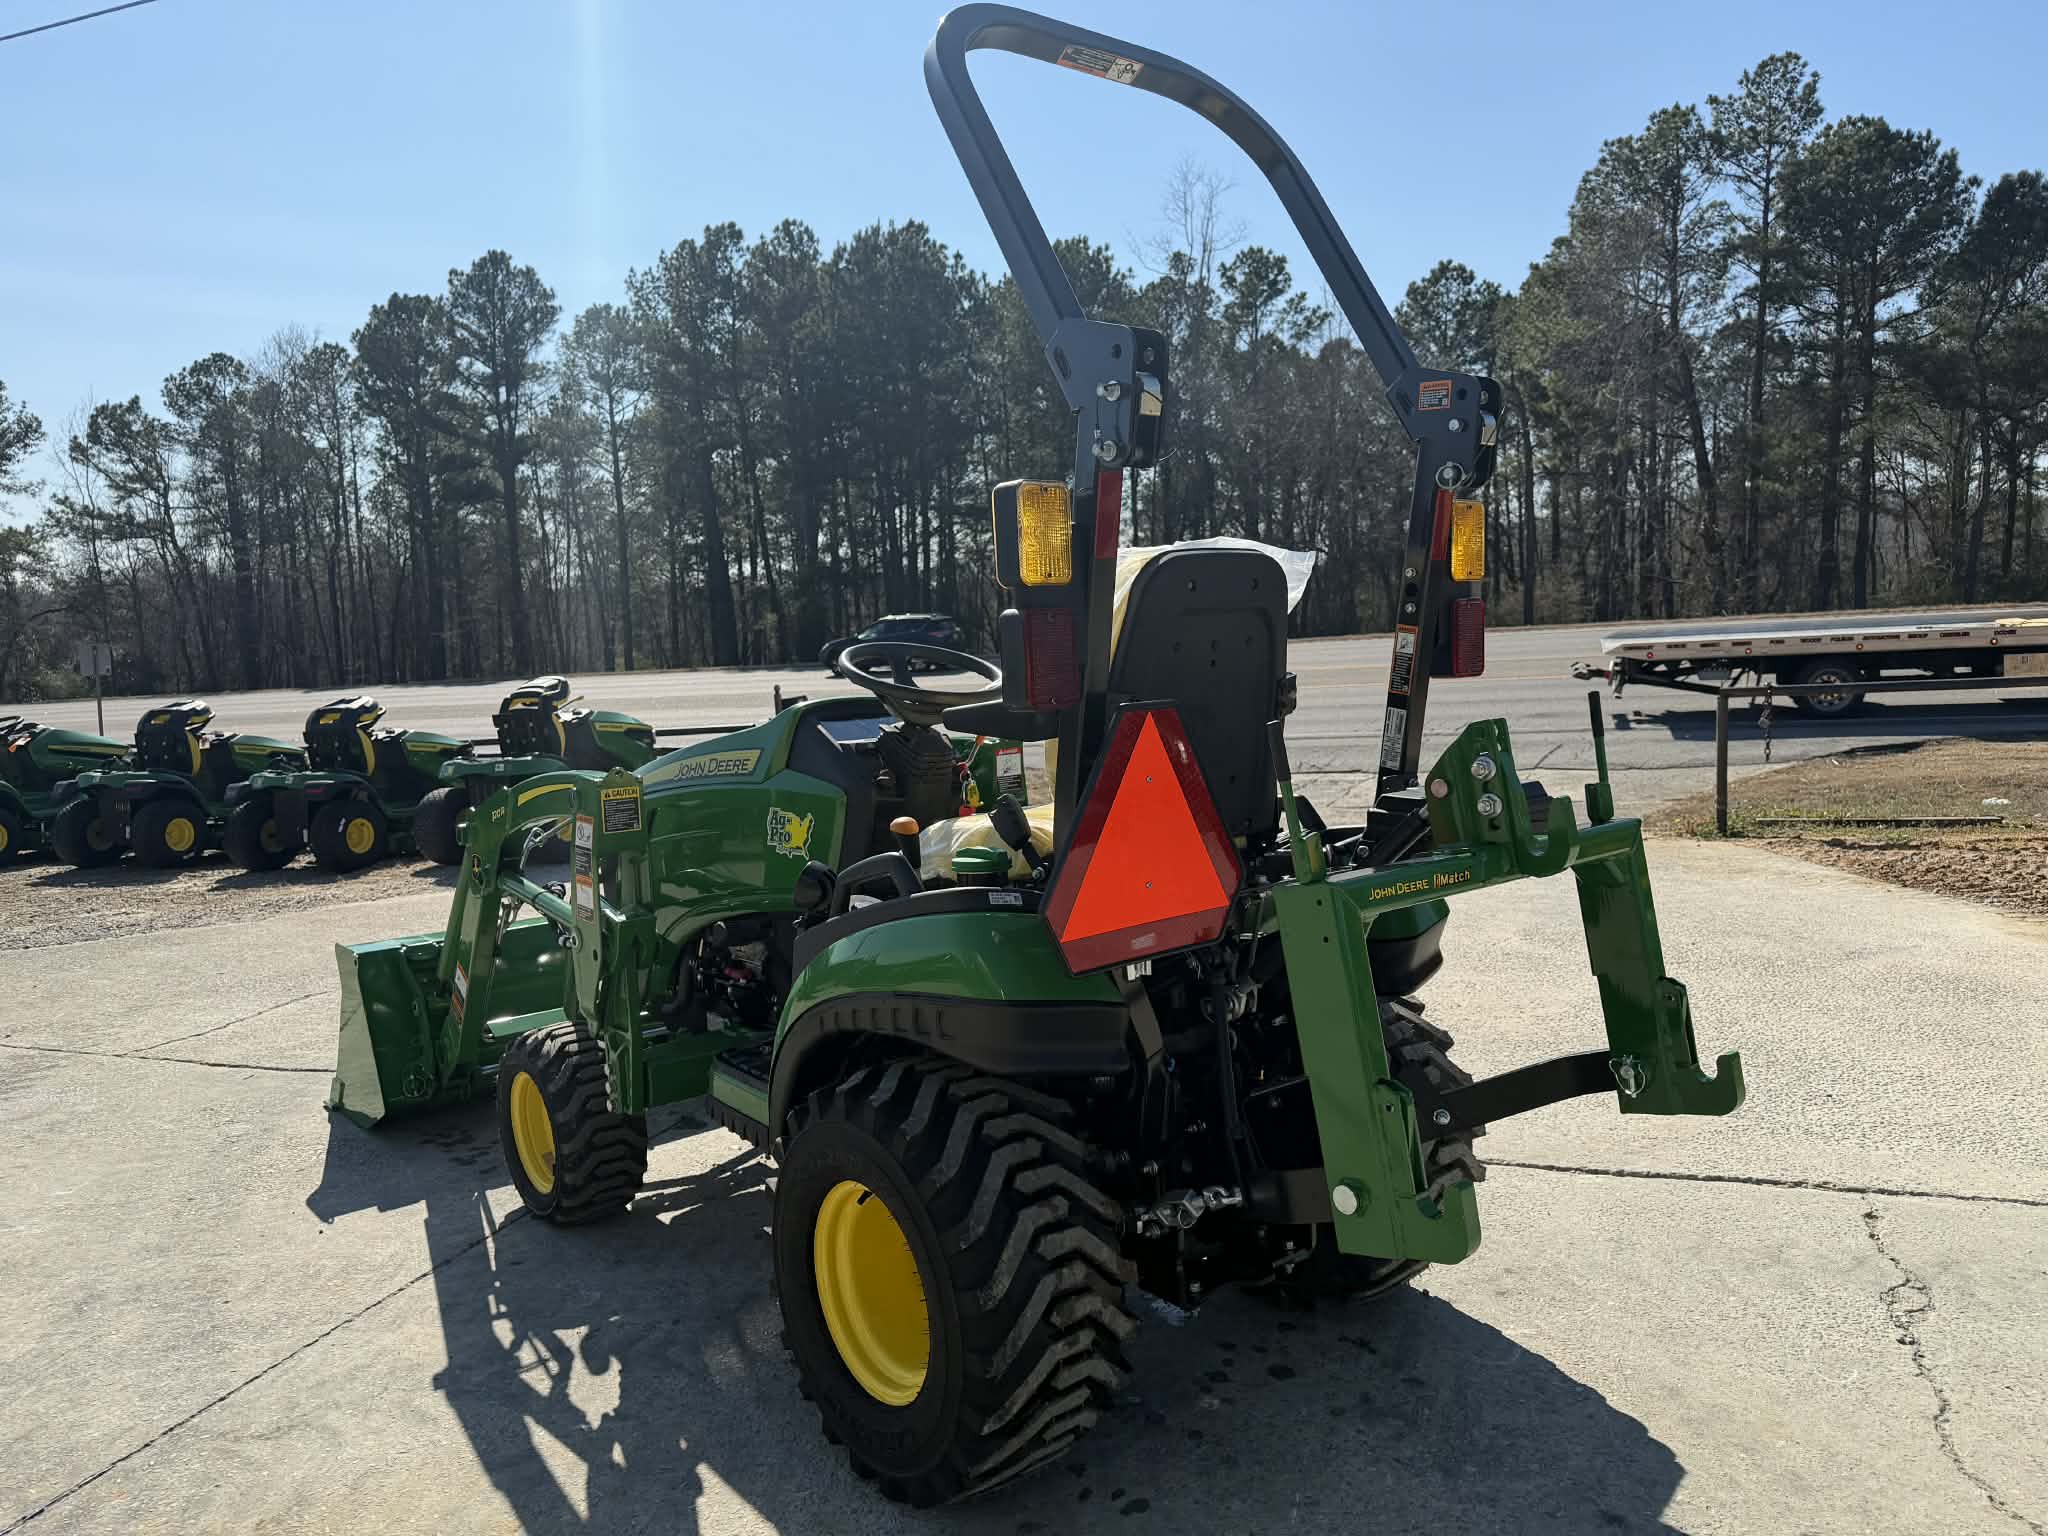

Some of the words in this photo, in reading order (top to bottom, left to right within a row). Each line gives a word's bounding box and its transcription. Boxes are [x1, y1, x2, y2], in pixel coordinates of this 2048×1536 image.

[672, 762, 706, 778] JOHN
[707, 758, 752, 774] DEERE
[611, 788, 638, 798] CAUTION
[769, 829, 792, 842] Pro
[1369, 885, 1396, 900] JOHN
[1396, 879, 1430, 894] DEERE
